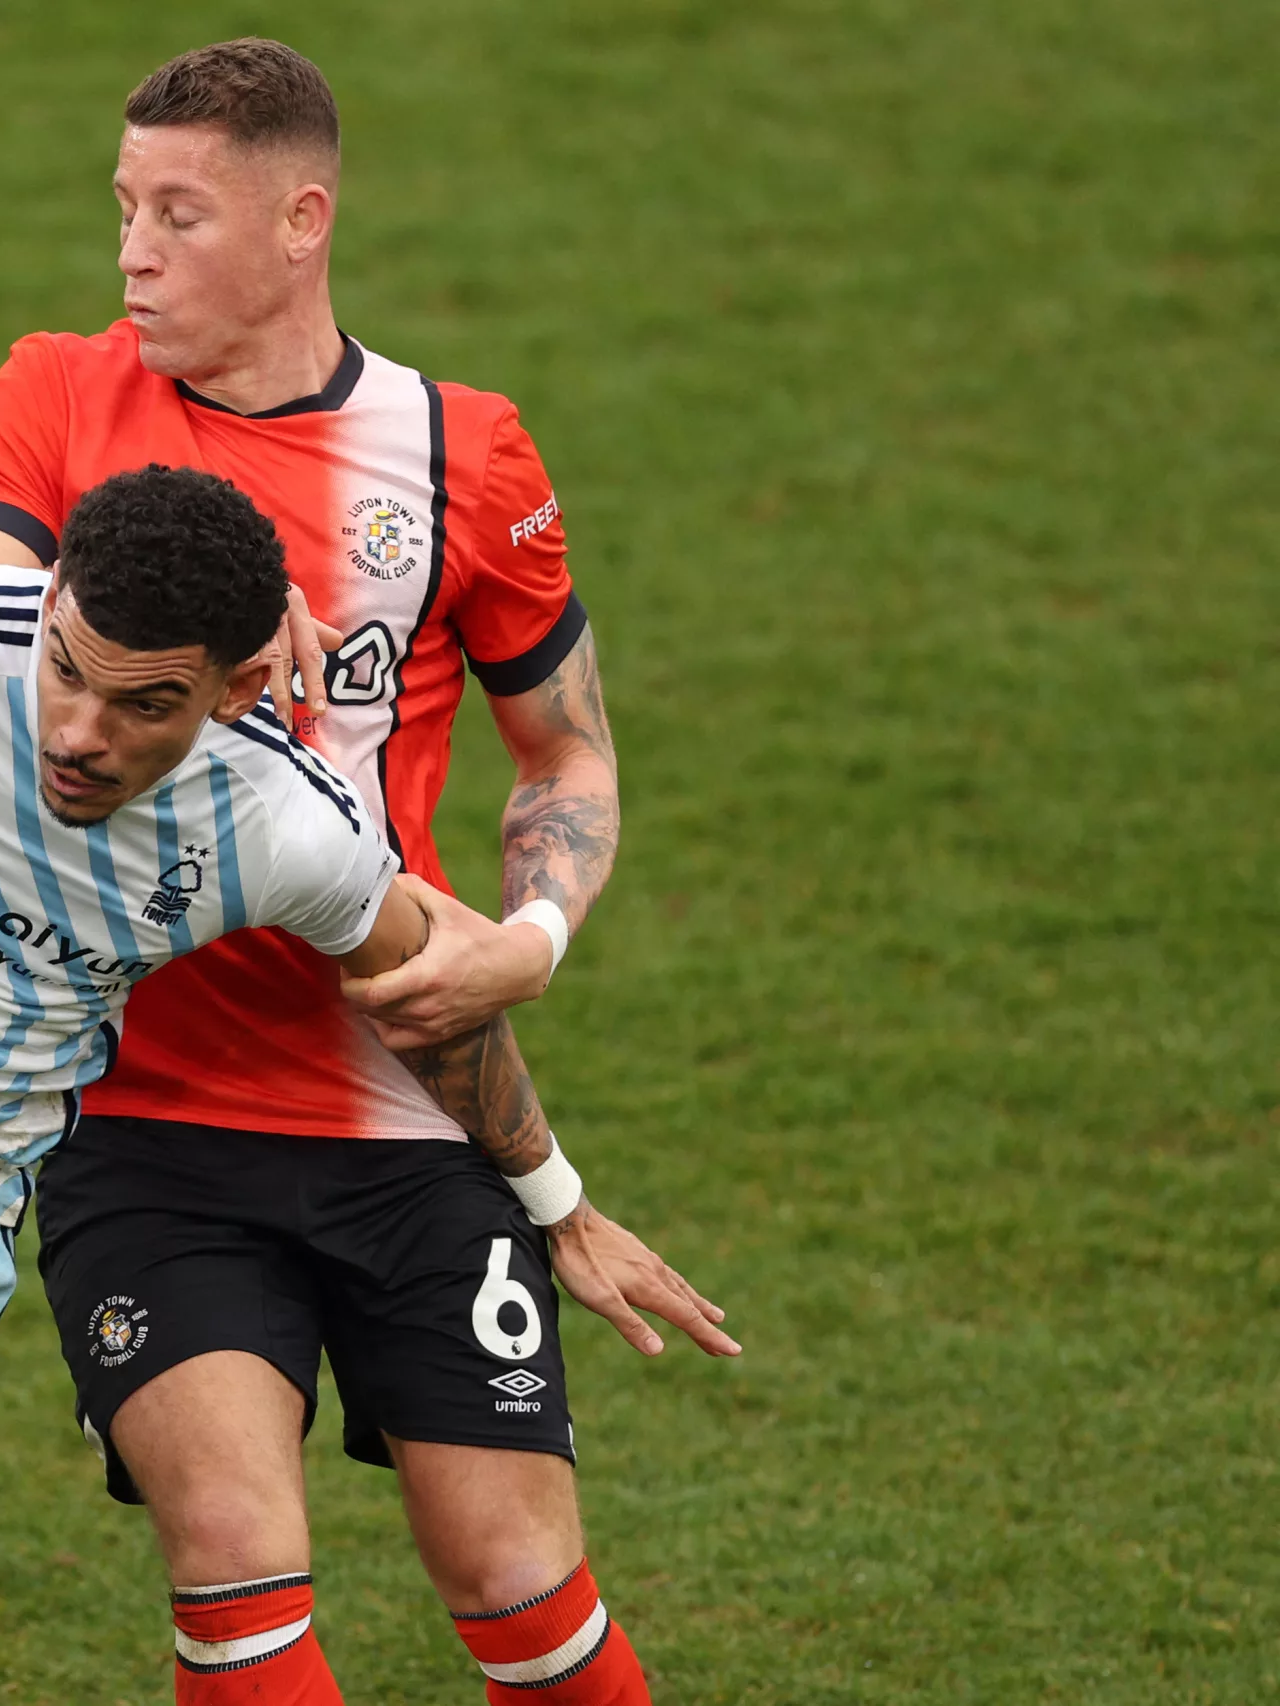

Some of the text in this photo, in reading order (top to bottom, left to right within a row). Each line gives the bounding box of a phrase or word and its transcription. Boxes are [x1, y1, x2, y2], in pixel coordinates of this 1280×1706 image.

[347, 497, 416, 526] LUTON TOWN
[347, 549, 417, 580] FOOTBALL CLUB
[87, 1295, 135, 1336] LUTON TOWN
[472, 1237, 542, 1360] 6
[99, 1326, 149, 1368] FOOTBALL CLUB
[494, 1399, 542, 1413] umbro
